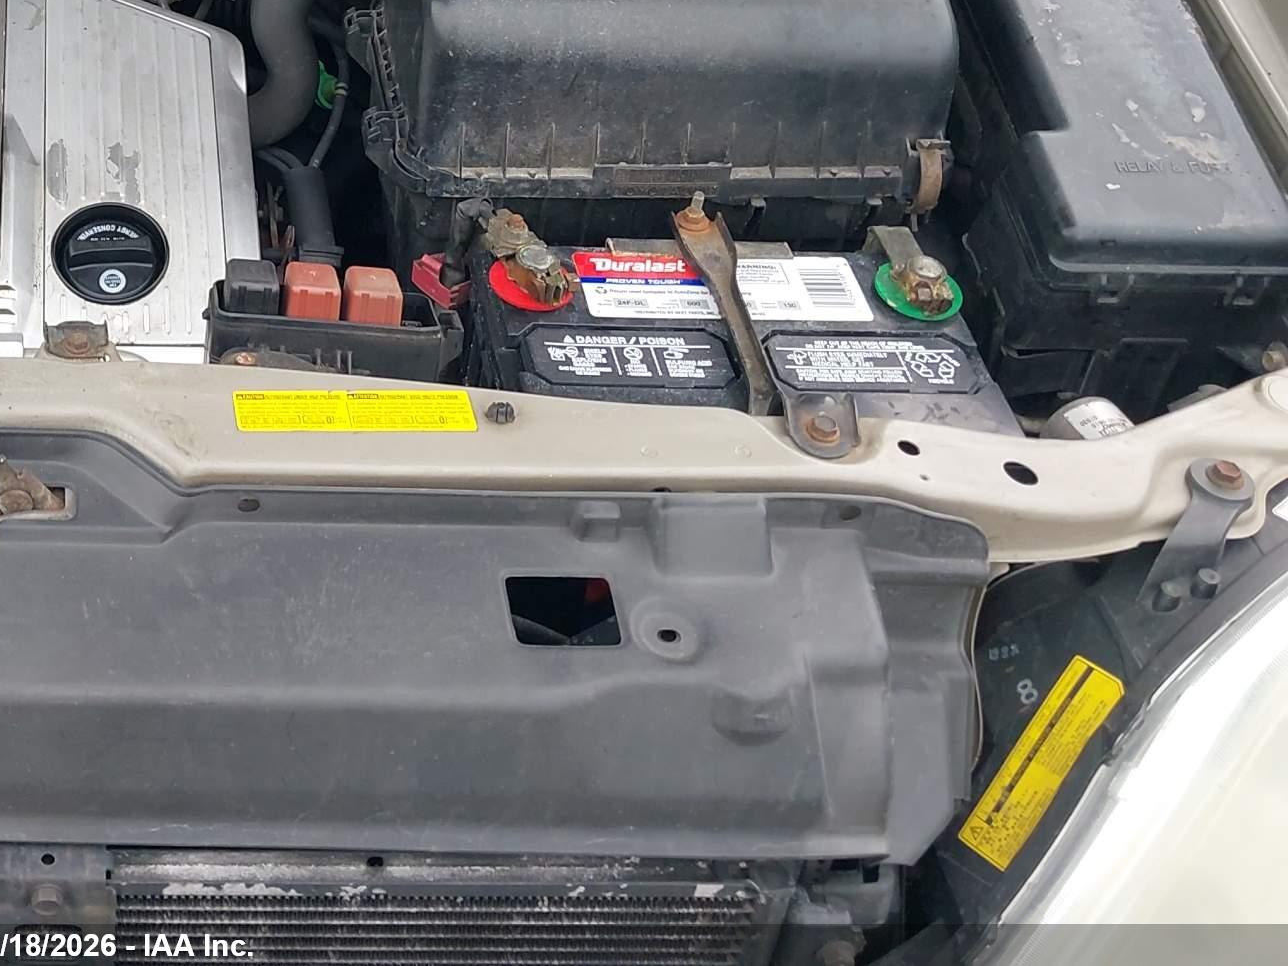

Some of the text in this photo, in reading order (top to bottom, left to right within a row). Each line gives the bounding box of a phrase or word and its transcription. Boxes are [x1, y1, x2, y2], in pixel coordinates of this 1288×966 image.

[589, 257, 687, 273] Duralast
[575, 336, 628, 345] DANGER
[638, 336, 686, 346] POISON
